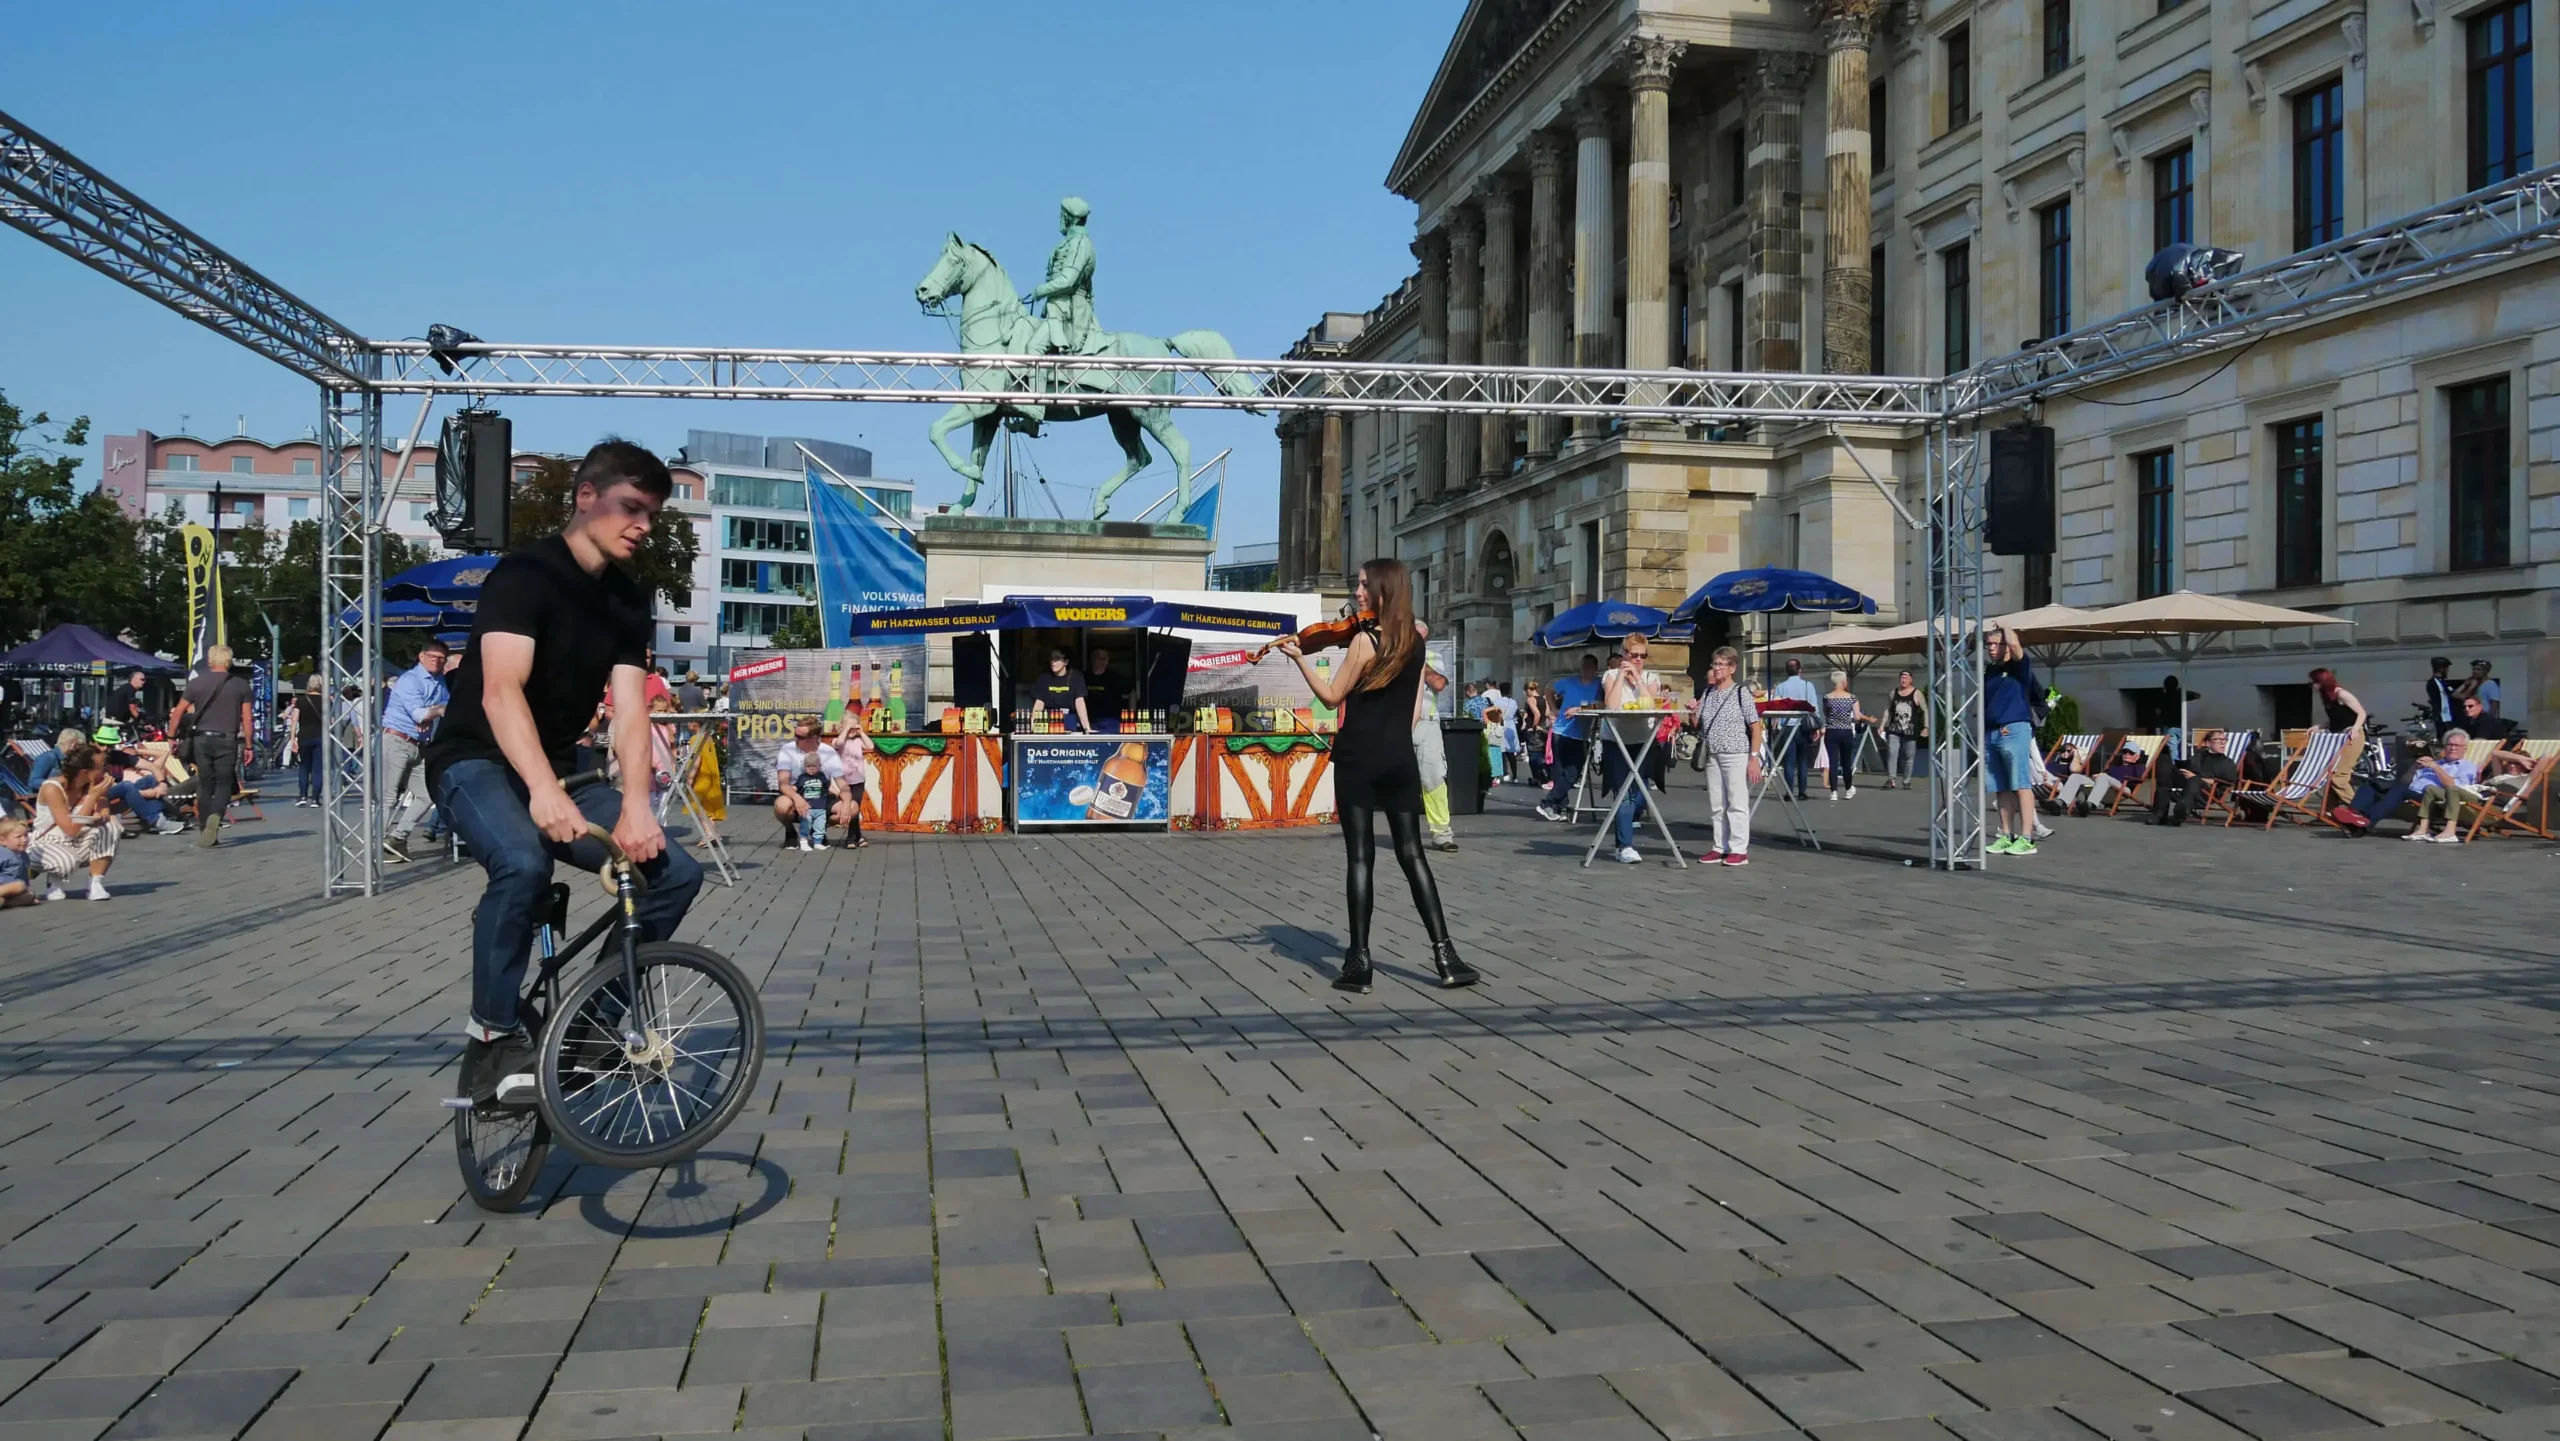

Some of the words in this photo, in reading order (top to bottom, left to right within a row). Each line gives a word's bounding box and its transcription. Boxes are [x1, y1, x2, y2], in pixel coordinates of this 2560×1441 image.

[1055, 608, 1127, 621] WOLTERS
[1181, 612, 1194, 622] MIT
[1195, 613, 1246, 627] HARZWASSER
[1247, 620, 1281, 630] GEBRAUT
[871, 619, 888, 629] MIT
[889, 617, 950, 628] HARZWASSER
[952, 615, 996, 625] GEBRAUT
[1187, 653, 1242, 669] PROBIEREN!
[733, 668, 748, 679] HIER
[747, 660, 784, 675] PROBIEREN!
[738, 700, 753, 710] WIR
[754, 700, 773, 710] SIND
[775, 700, 788, 710] DIE
[1200, 696, 1230, 707] SIND
[1231, 696, 1250, 707] DIE
[1027, 748, 1049, 757] DAS
[1050, 748, 1099, 757] ORIGINAL
